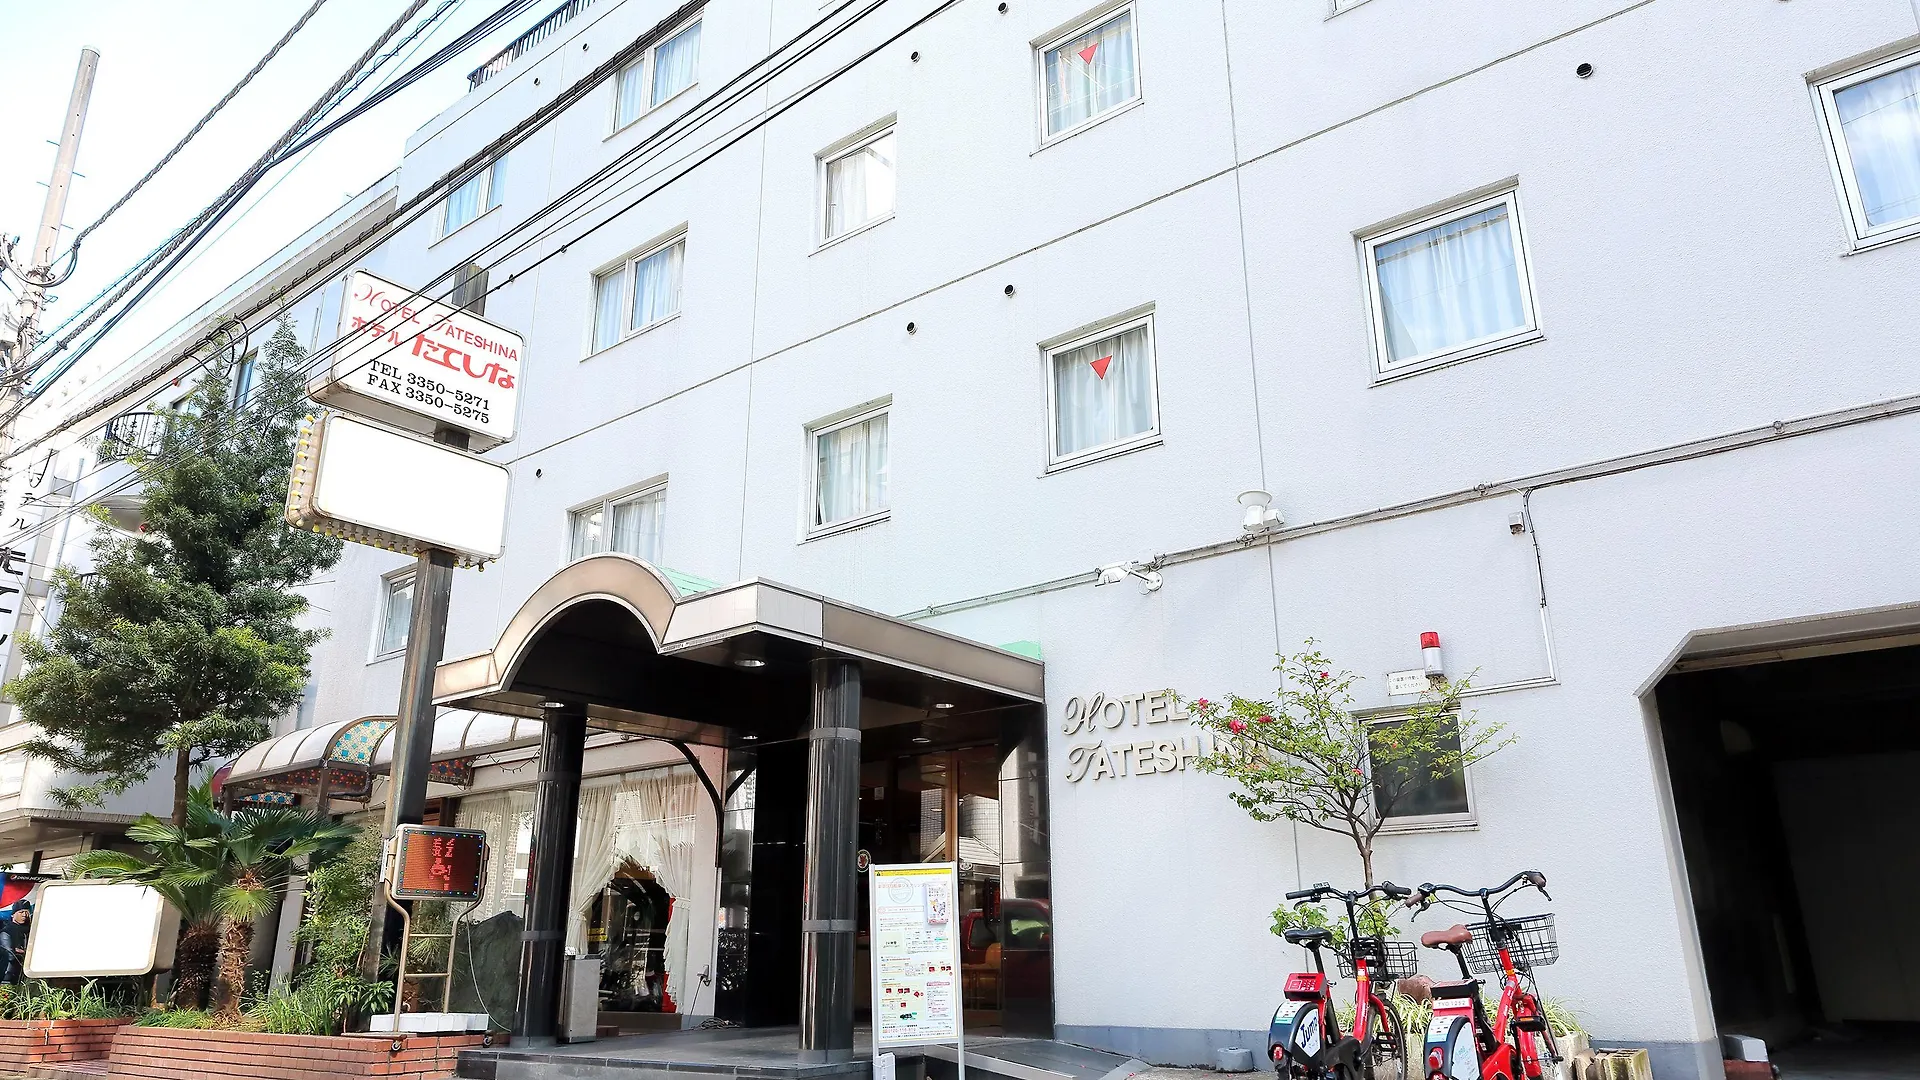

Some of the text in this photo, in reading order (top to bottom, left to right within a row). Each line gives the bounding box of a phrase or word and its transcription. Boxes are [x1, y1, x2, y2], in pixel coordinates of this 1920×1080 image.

[354, 283, 518, 361] HOTEL TATESHINA
[351, 316, 515, 389] ホテル たてしな
[367, 373, 490, 424] FAX 3350-5275
[370, 359, 490, 411] TEL 3350-5271
[1060, 688, 1189, 736] HOTEL
